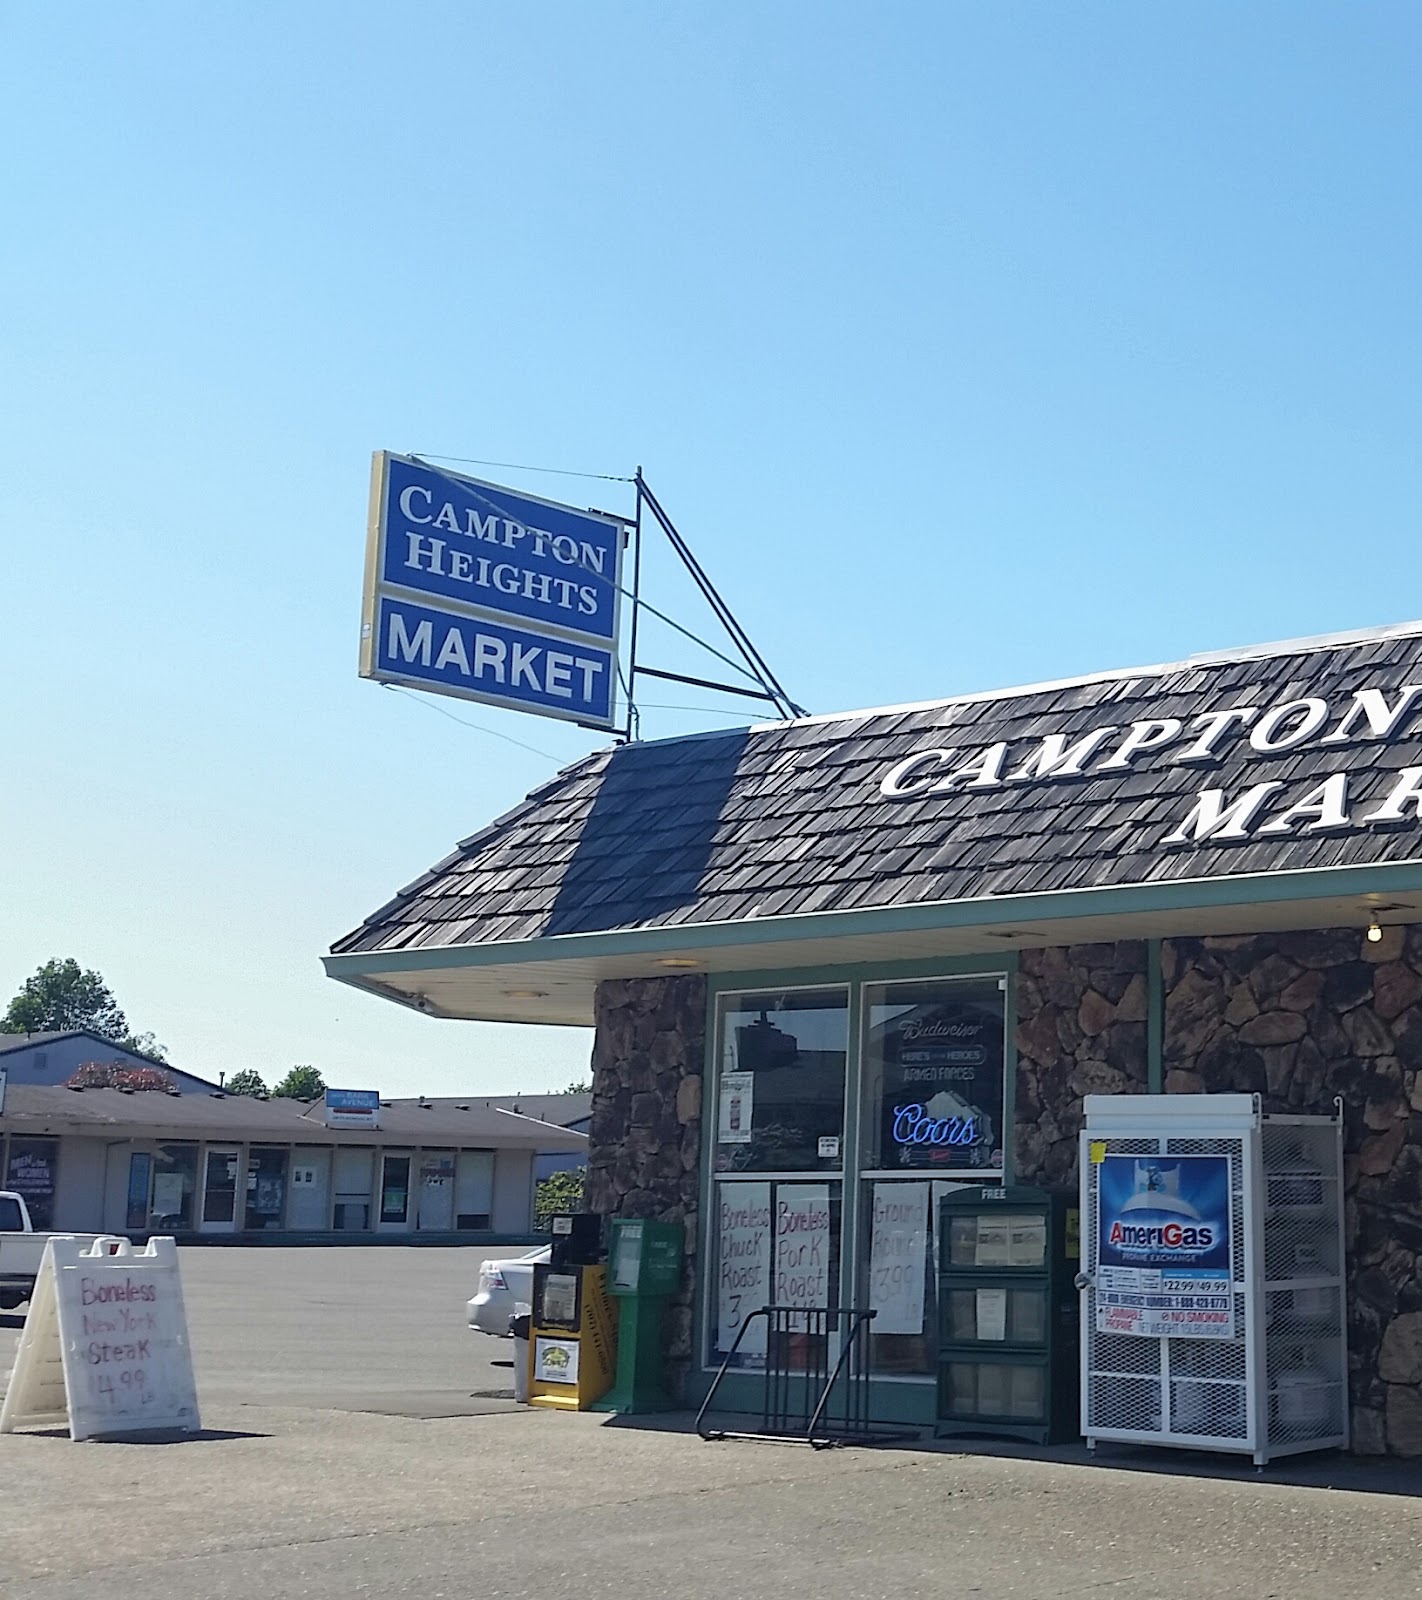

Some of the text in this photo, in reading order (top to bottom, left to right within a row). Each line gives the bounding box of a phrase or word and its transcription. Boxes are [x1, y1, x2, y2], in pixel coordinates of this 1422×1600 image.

[399, 485, 607, 573] CAMPTON
[403, 531, 598, 616] HEIGHTS
[387, 612, 603, 703] MARKET
[899, 1019, 984, 1040] Budweiser
[904, 1067, 975, 1082] ARMED FORCES
[893, 1103, 978, 1144] Coors
[981, 1188, 1007, 1200] FREE
[777, 1201, 829, 1235] Boneless
[873, 1195, 924, 1223] Ground
[620, 1228, 643, 1239] FREE
[1109, 1221, 1214, 1246] AmeriGas
[721, 1260, 762, 1290] Roast
[777, 1268, 824, 1301] Roast
[81, 1278, 157, 1305] Boneless
[1171, 1312, 1185, 1322] NO
[1187, 1312, 1229, 1323] SMOKING
